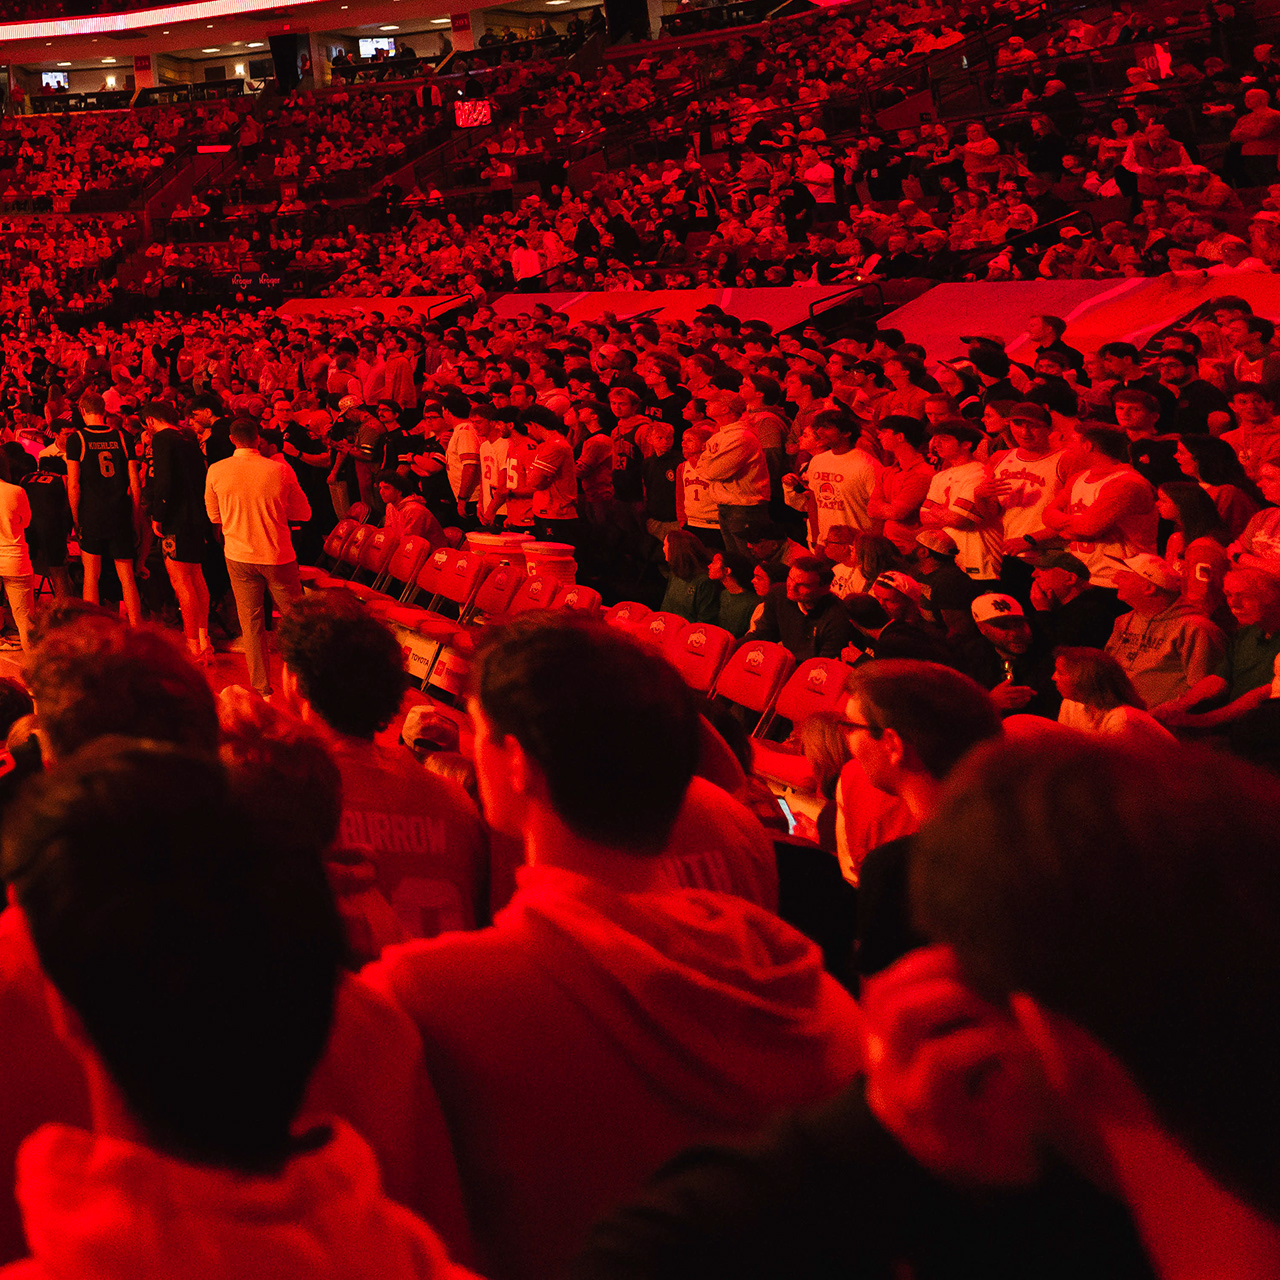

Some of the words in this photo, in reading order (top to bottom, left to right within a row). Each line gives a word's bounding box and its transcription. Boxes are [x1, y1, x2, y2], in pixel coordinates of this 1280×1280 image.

[231, 273, 253, 290] Kroger
[258, 272, 281, 288] Kroger
[88, 441, 120, 451] KOEHLER
[98, 450, 116, 478] 6
[693, 489, 700, 502] 1
[1195, 562, 1211, 582] C
[410, 651, 430, 667] TOYOTA
[339, 807, 447, 855] BURROW
